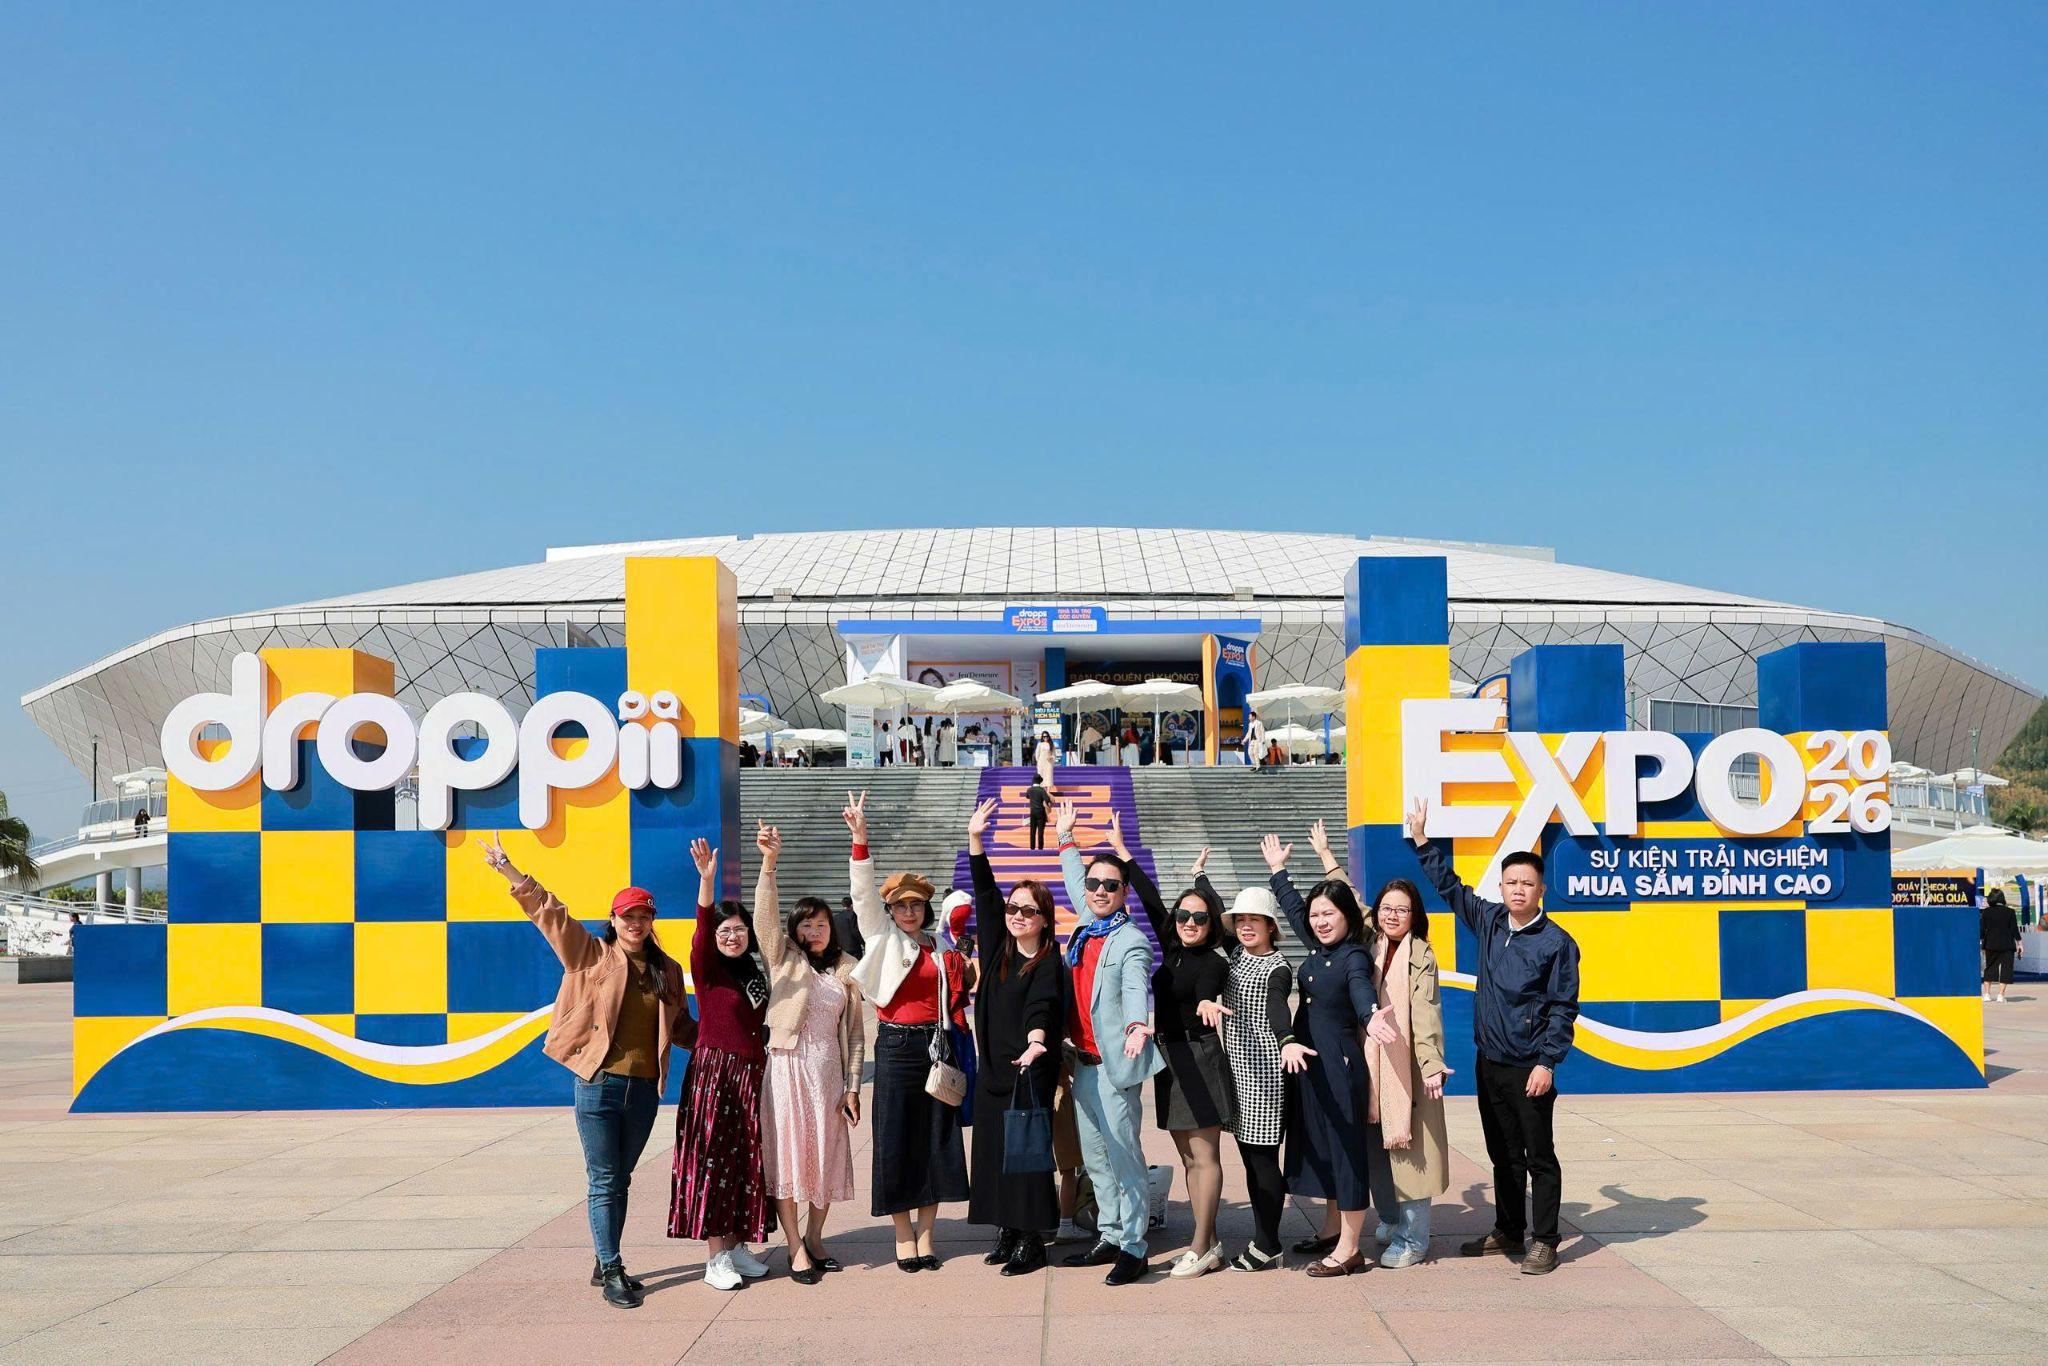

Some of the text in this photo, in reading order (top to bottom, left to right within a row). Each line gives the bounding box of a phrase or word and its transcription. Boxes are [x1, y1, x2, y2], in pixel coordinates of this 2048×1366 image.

[161, 651, 682, 830] droppii
[1807, 730, 1891, 781] 20
[1401, 698, 1808, 896] EXPO
[1808, 782, 1892, 834] 26
[1568, 868, 1832, 896] MUA SẮM ĐỈNH CAO
[1590, 844, 1828, 872] SỰ KIỆN TRẢI NGHIỆM
